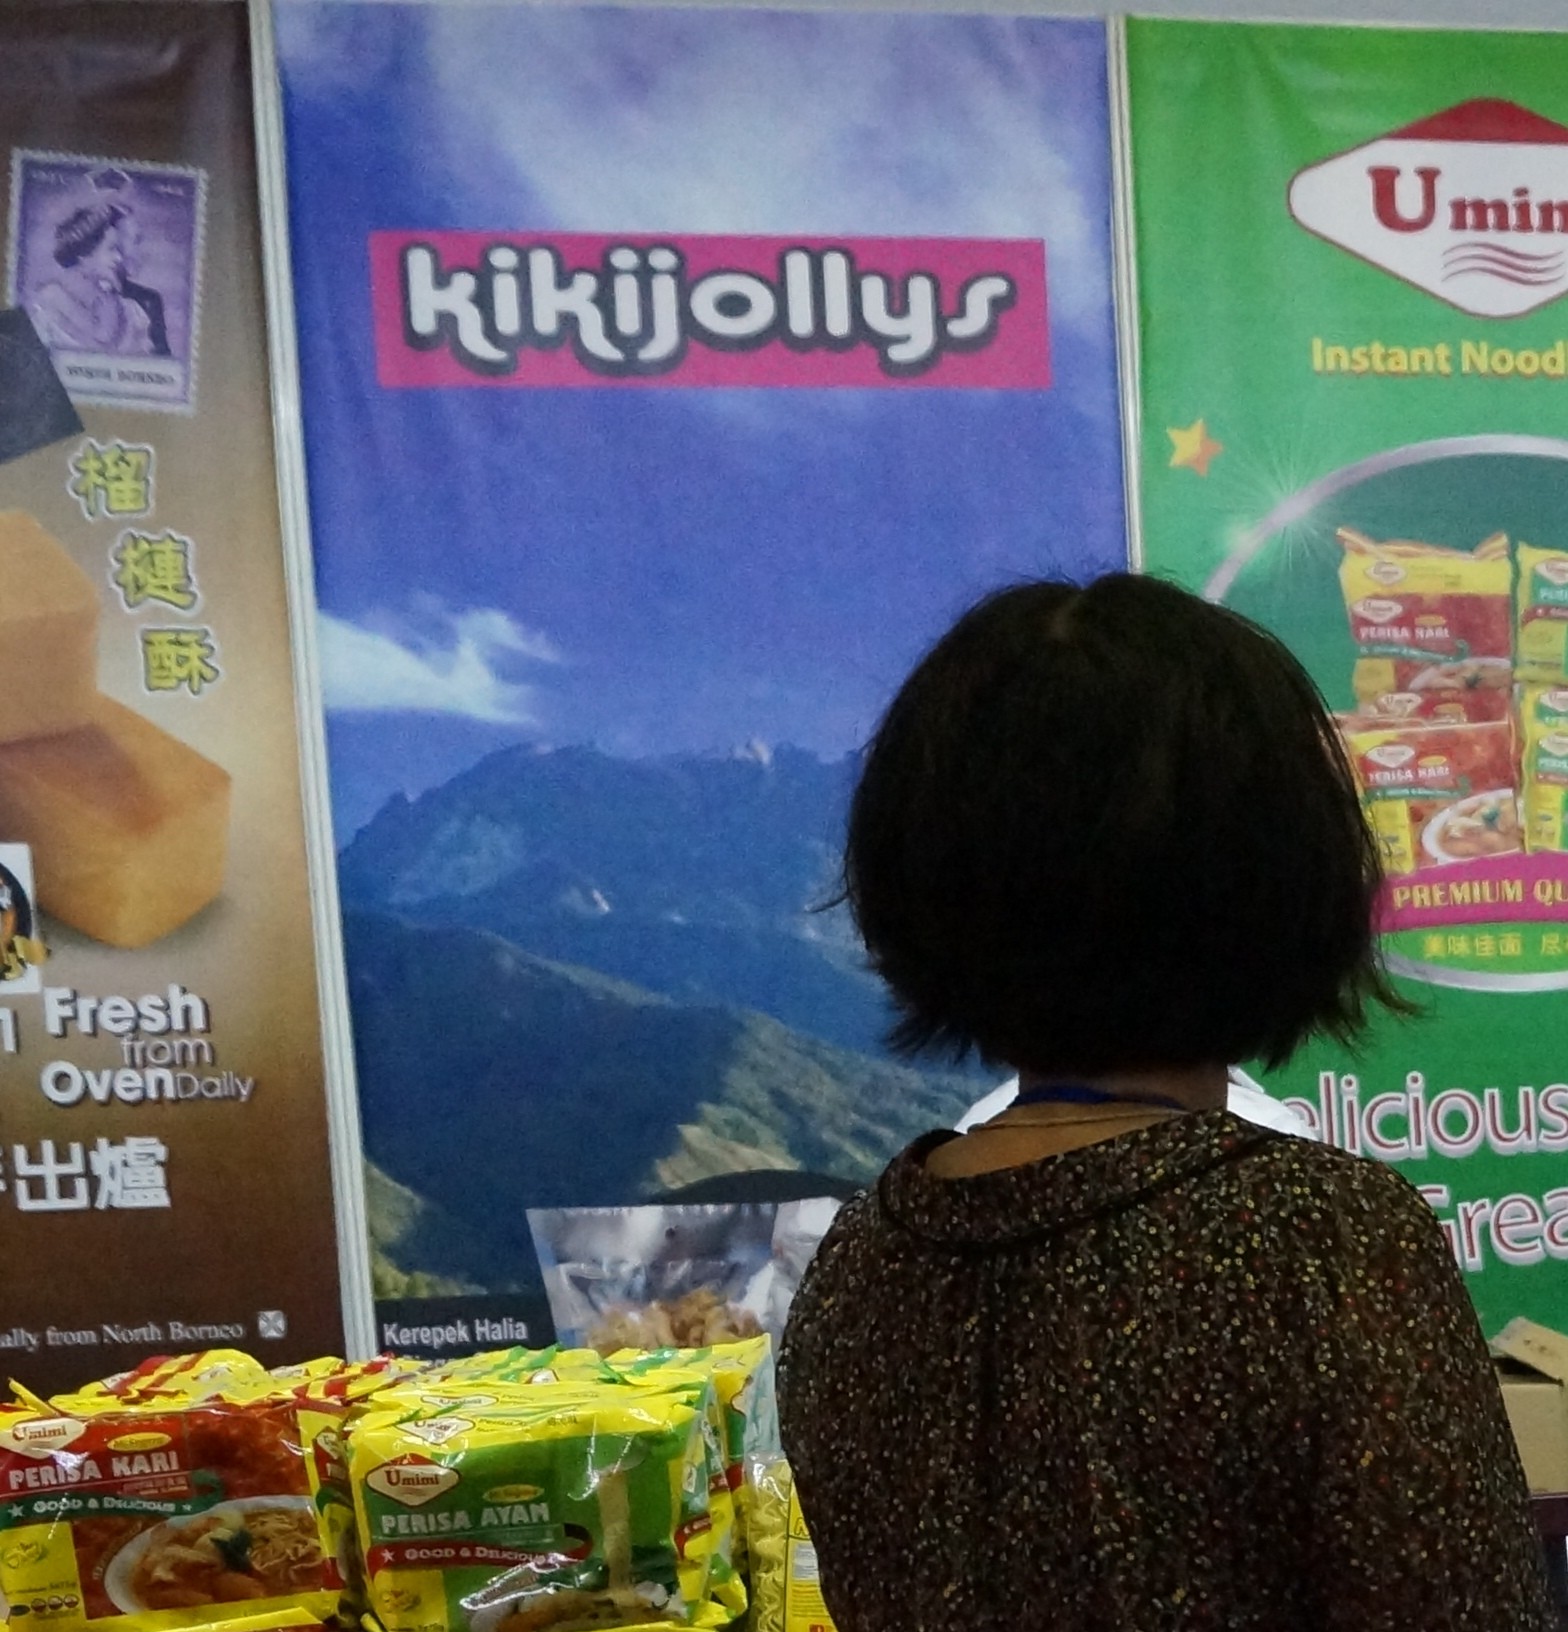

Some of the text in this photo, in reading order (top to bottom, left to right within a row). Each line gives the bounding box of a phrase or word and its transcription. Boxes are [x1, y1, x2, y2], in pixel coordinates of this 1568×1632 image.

[403, 244, 1015, 372] kikijollys
[1311, 337, 1452, 376] Instant
[1392, 880, 1524, 911] PREMIUM
[44, 983, 209, 1037] Fresh
[121, 1033, 213, 1068] from
[0, 1135, 172, 1213] 出爐
[46, 1324, 98, 1346] from
[102, 1319, 162, 1344] North
[170, 1318, 243, 1341] Borneo
[383, 1316, 528, 1349] Kerepek Halia
[9, 1461, 103, 1490] PERISA
[112, 1450, 180, 1479] KARI
[385, 1470, 440, 1488] Umimi
[381, 1502, 552, 1535] PERISA AYAM
[404, 1546, 457, 1561] GOOD
